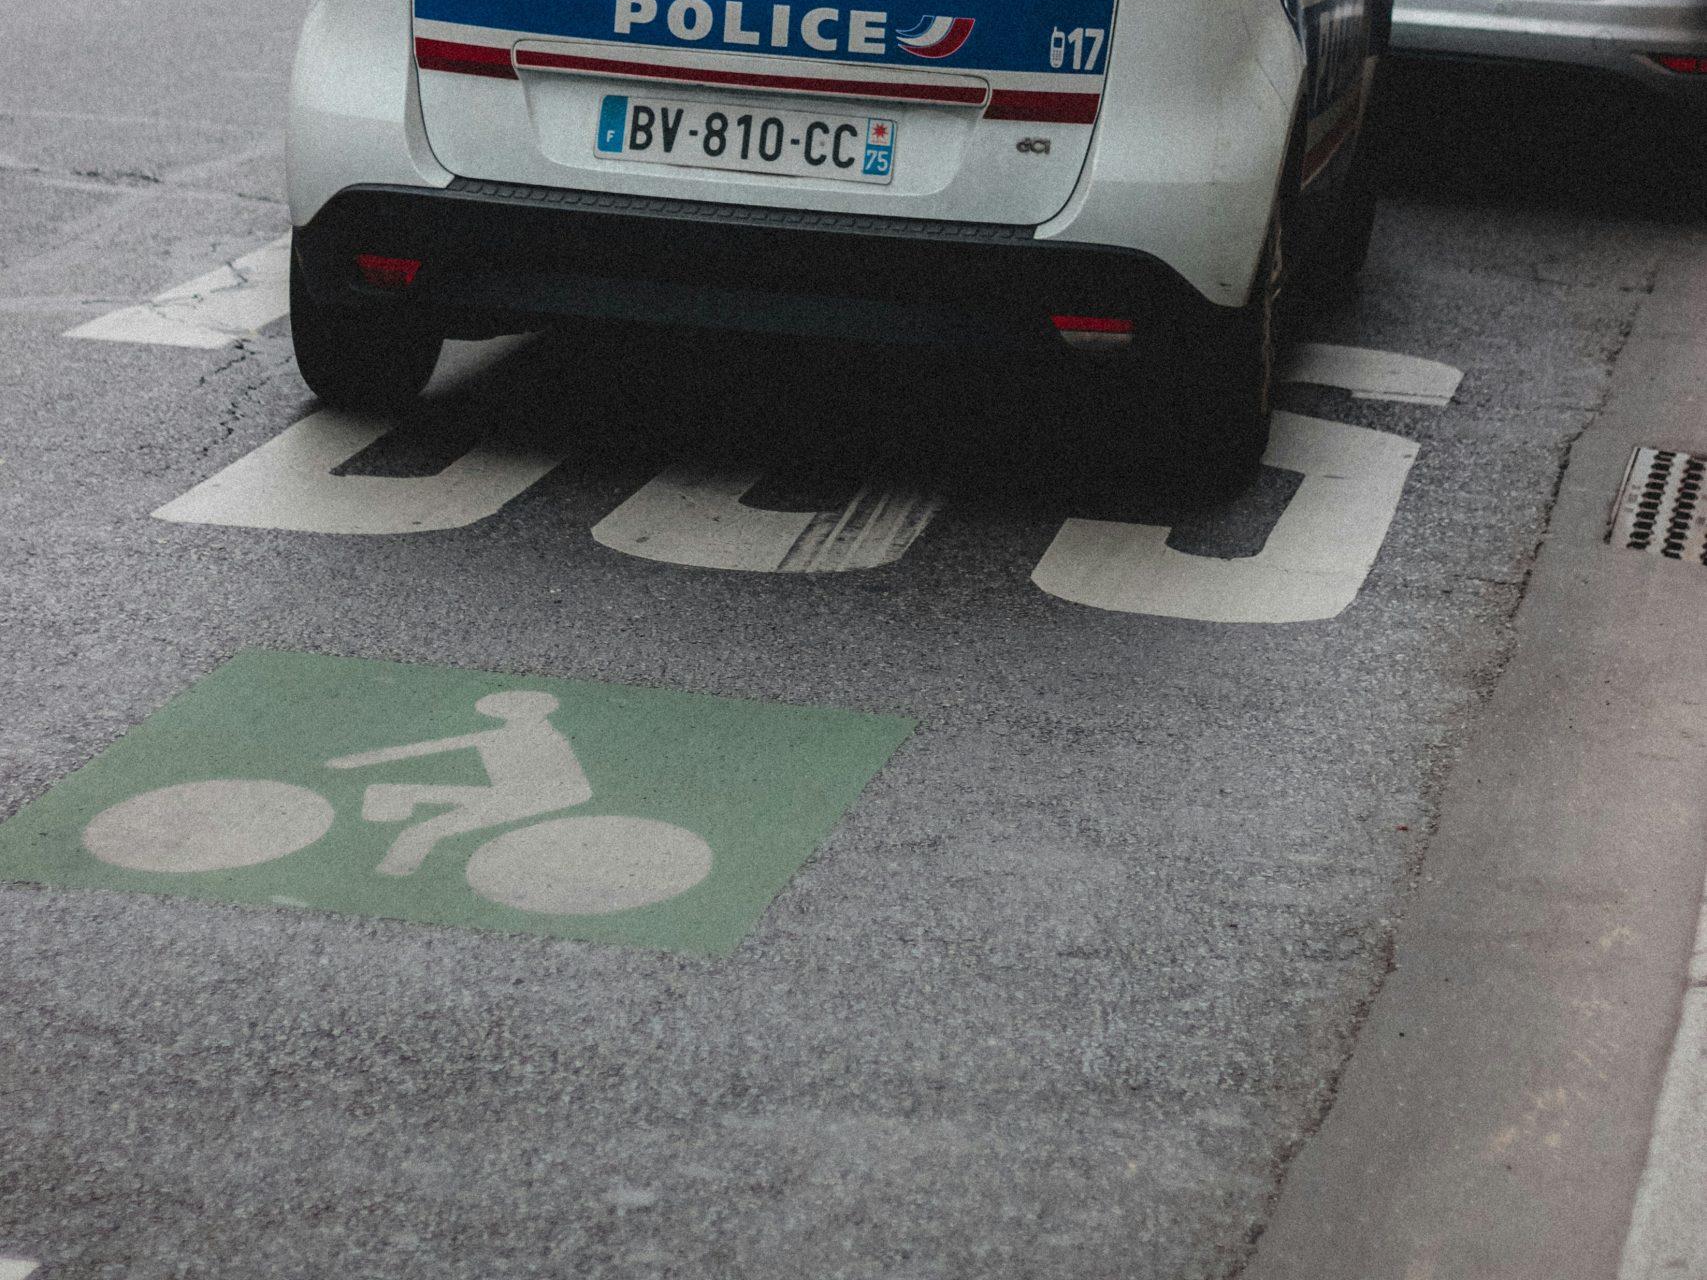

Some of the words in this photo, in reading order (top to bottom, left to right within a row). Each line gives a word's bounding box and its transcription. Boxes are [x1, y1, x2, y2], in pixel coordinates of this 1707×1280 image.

[1067, 27, 1105, 71] 17
[606, 130, 616, 144] F
[629, 105, 858, 169] BV-810-CC
[865, 149, 890, 173] 75
